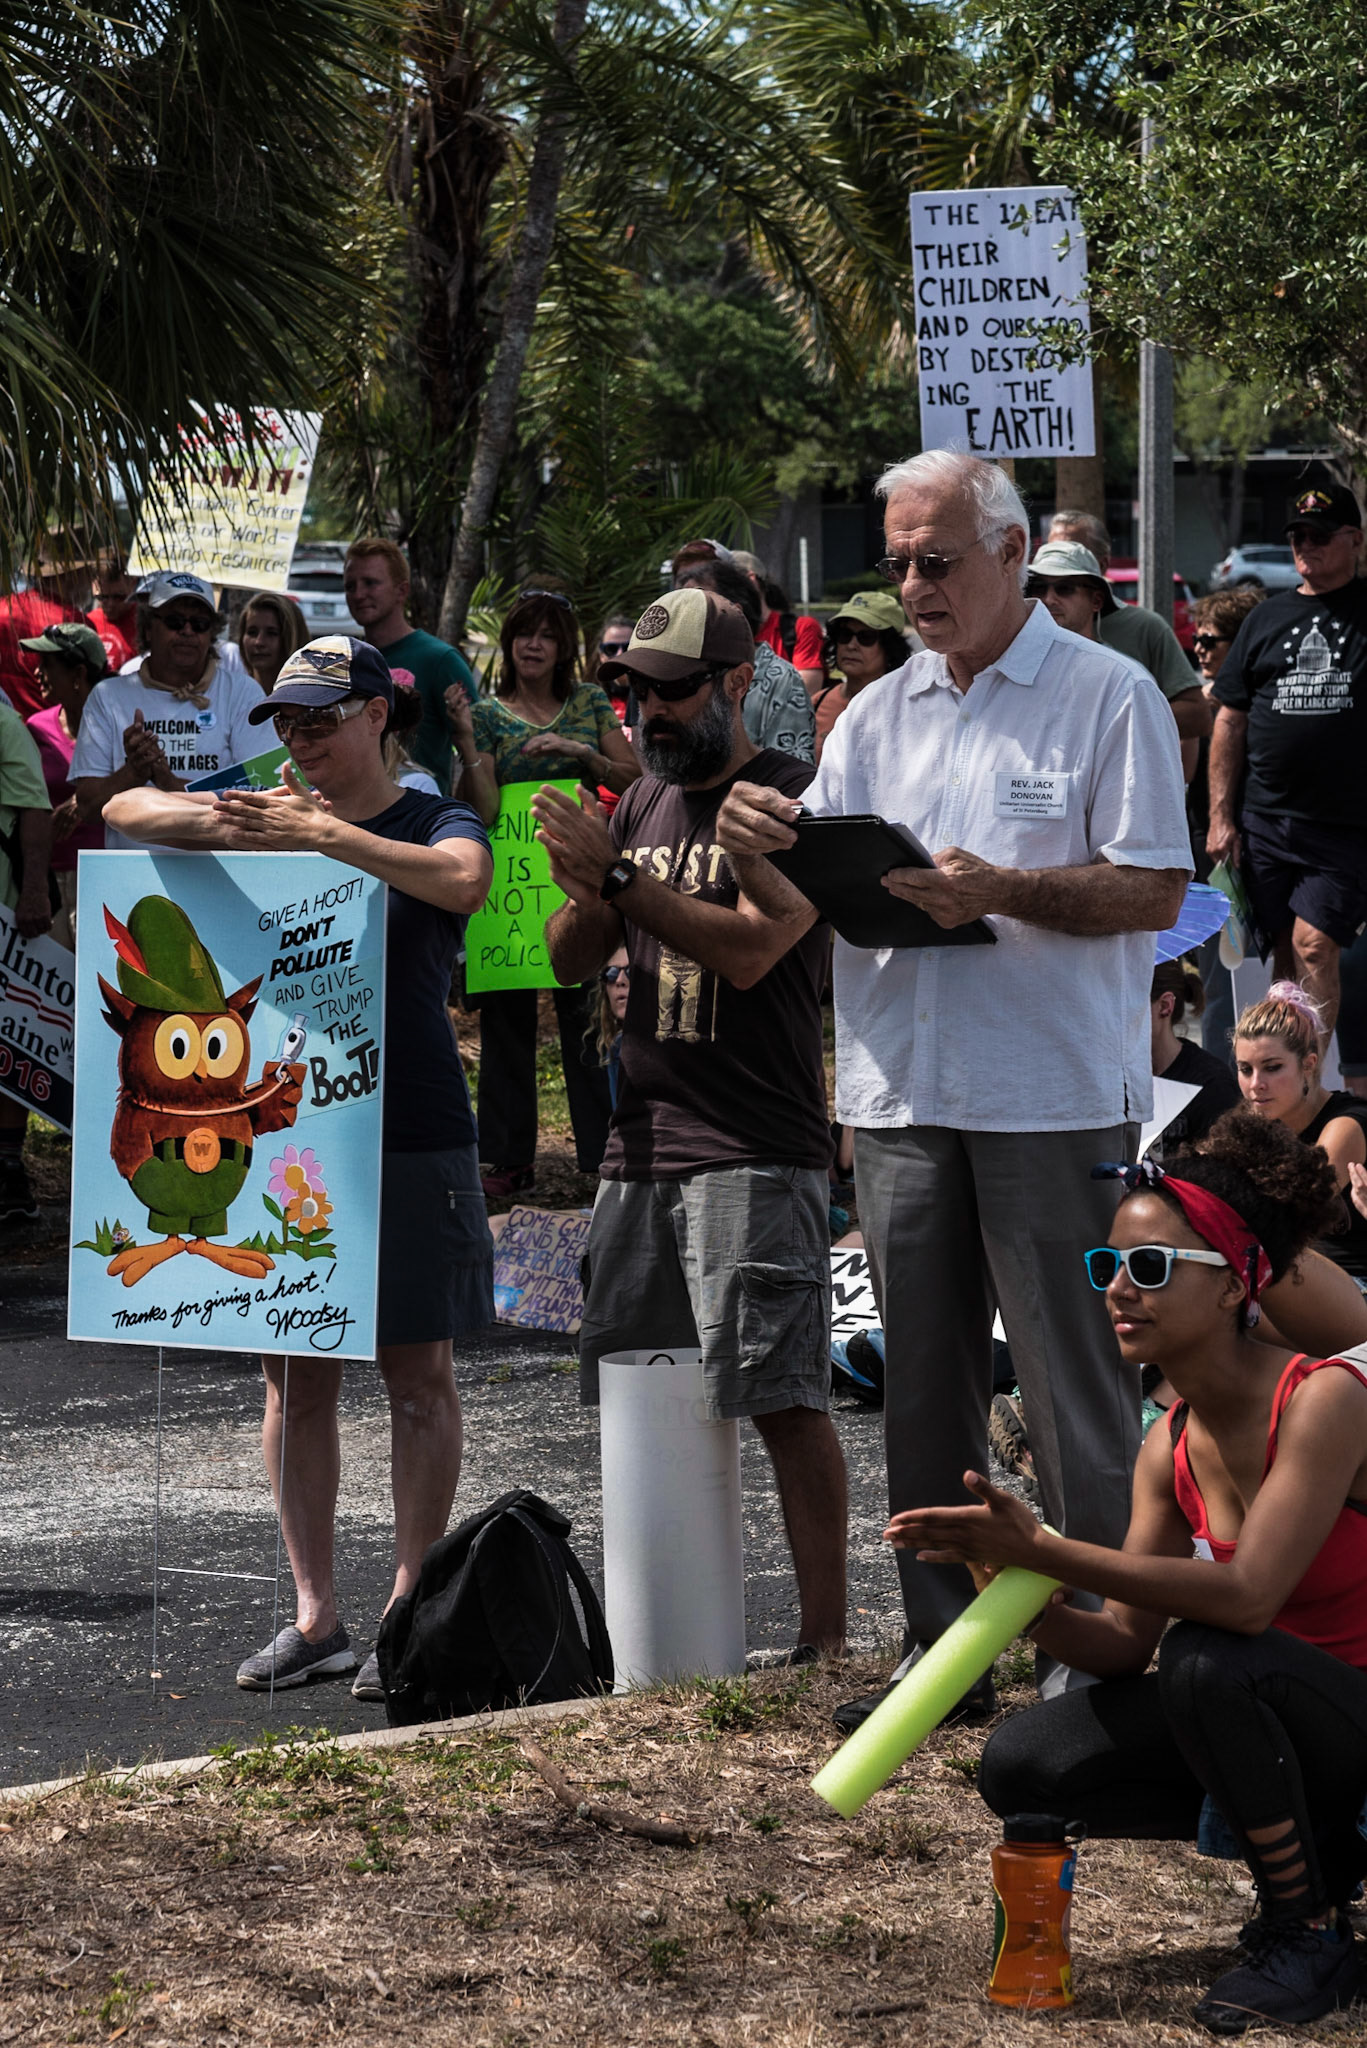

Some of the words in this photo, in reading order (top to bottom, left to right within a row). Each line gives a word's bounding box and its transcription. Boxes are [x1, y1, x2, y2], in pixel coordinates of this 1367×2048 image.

[924, 203, 980, 225] THE
[1035, 196, 1078, 224] EAT
[915, 241, 999, 270] THEIR
[918, 276, 1062, 308] CHILDREN,
[918, 316, 969, 340] AND
[920, 347, 949, 372] BY
[927, 382, 970, 406] ING
[1003, 379, 1055, 403] THE
[966, 406, 1075, 451] EARTH!
[144, 720, 202, 735] WELCOME
[170, 738, 195, 751] THE
[188, 754, 219, 771] AGES
[1010, 792, 1053, 800] DONOVAN
[1011, 779, 1031, 788] REV.
[1032, 780, 1054, 789] JACK
[507, 856, 531, 883] IS
[258, 902, 297, 932] GIVE
[298, 899, 309, 918] A
[313, 877, 364, 913] HOOT!
[483, 885, 550, 916] NOT
[280, 915, 336, 950] DON'T
[508, 919, 523, 938] A
[269, 939, 353, 981] POLLUTE
[481, 944, 552, 970] POLIC
[275, 984, 305, 1006] AND
[311, 964, 364, 996] GIVE
[312, 987, 374, 1022] TRUMP
[323, 1013, 368, 1045] THE
[193, 1142, 211, 1157] W
[508, 1208, 559, 1233] COME
[111, 1304, 167, 1329] Thanks
[171, 1300, 201, 1329] for
[200, 1286, 251, 1327] giving
[254, 1286, 269, 1301] a
[268, 1262, 337, 1301] hoot!
[266, 1302, 356, 1351] Woodsy
